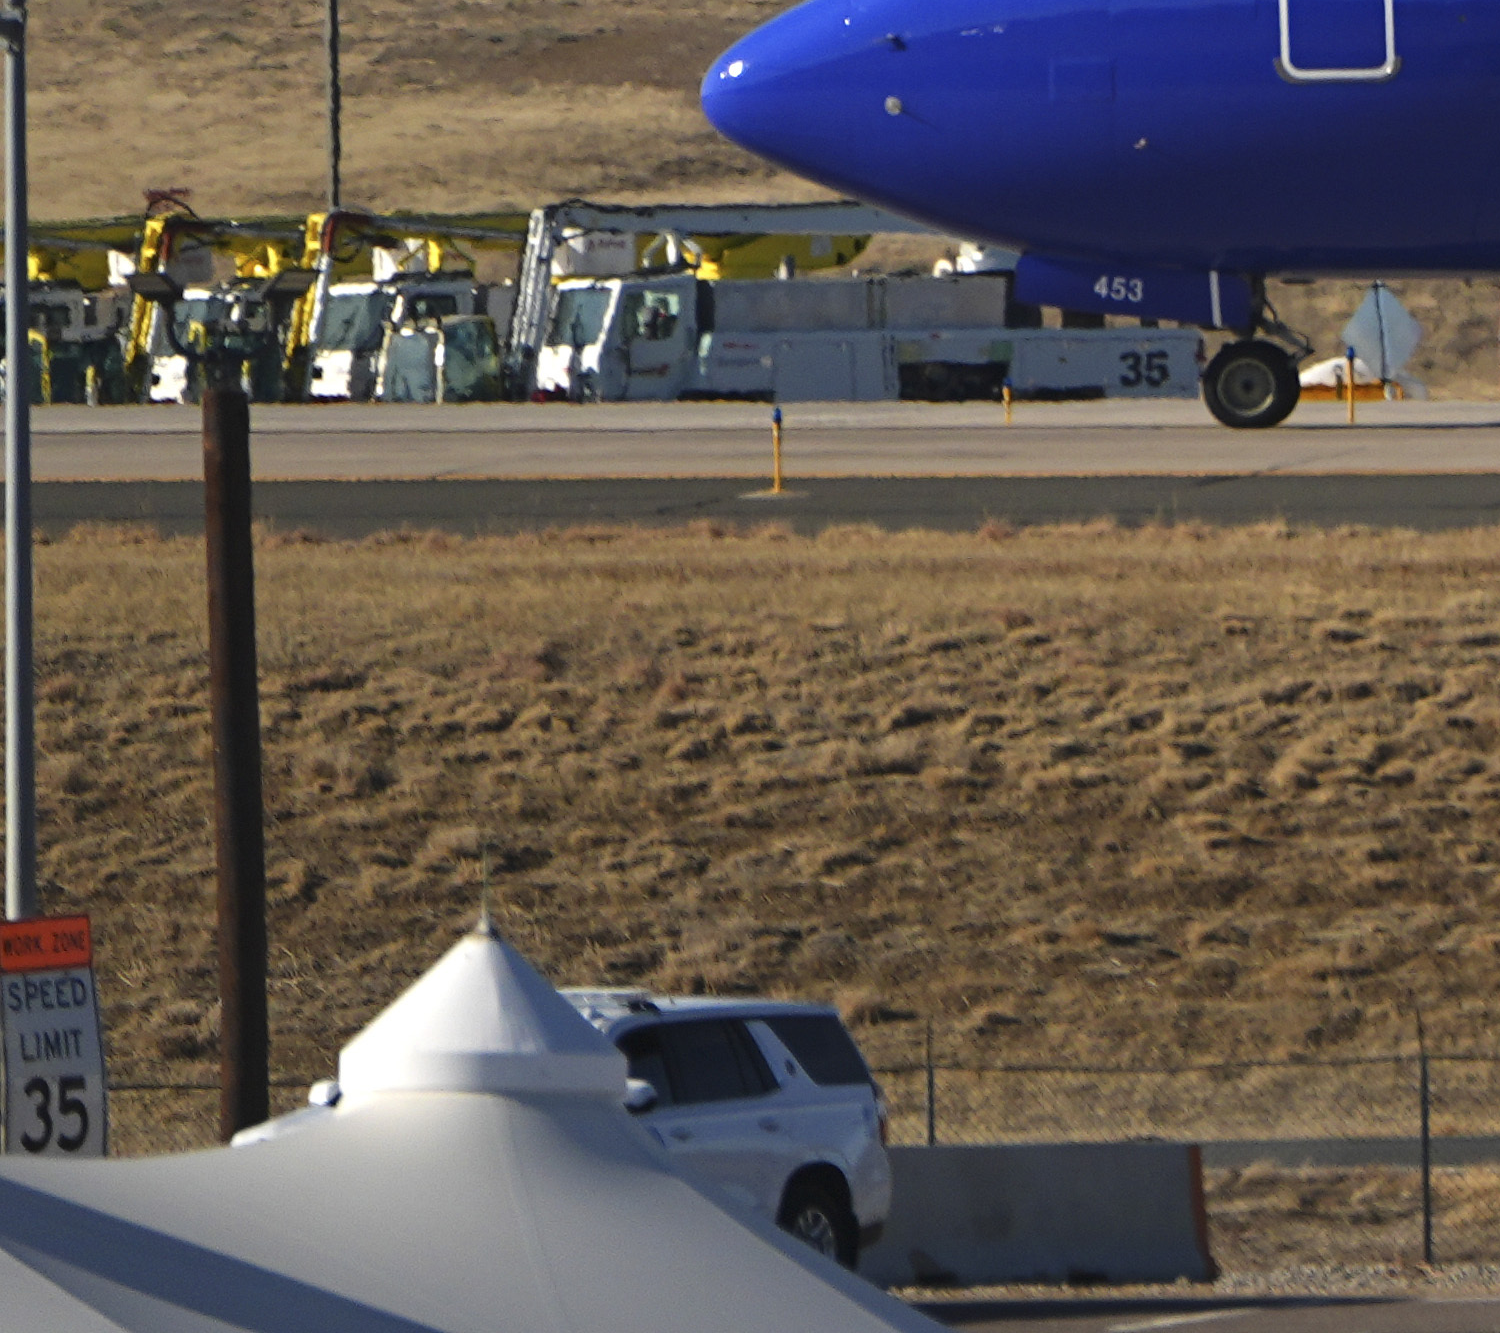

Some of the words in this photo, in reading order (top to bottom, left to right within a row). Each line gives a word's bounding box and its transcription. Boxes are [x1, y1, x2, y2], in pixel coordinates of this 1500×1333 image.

[1094, 275, 1144, 303] 453
[1119, 351, 1170, 389] 35
[3, 934, 43, 957] WORK
[52, 929, 86, 953] ZONE
[7, 975, 88, 1012] SPEED
[20, 1027, 82, 1062] LIMIT
[20, 1073, 90, 1155] 35
